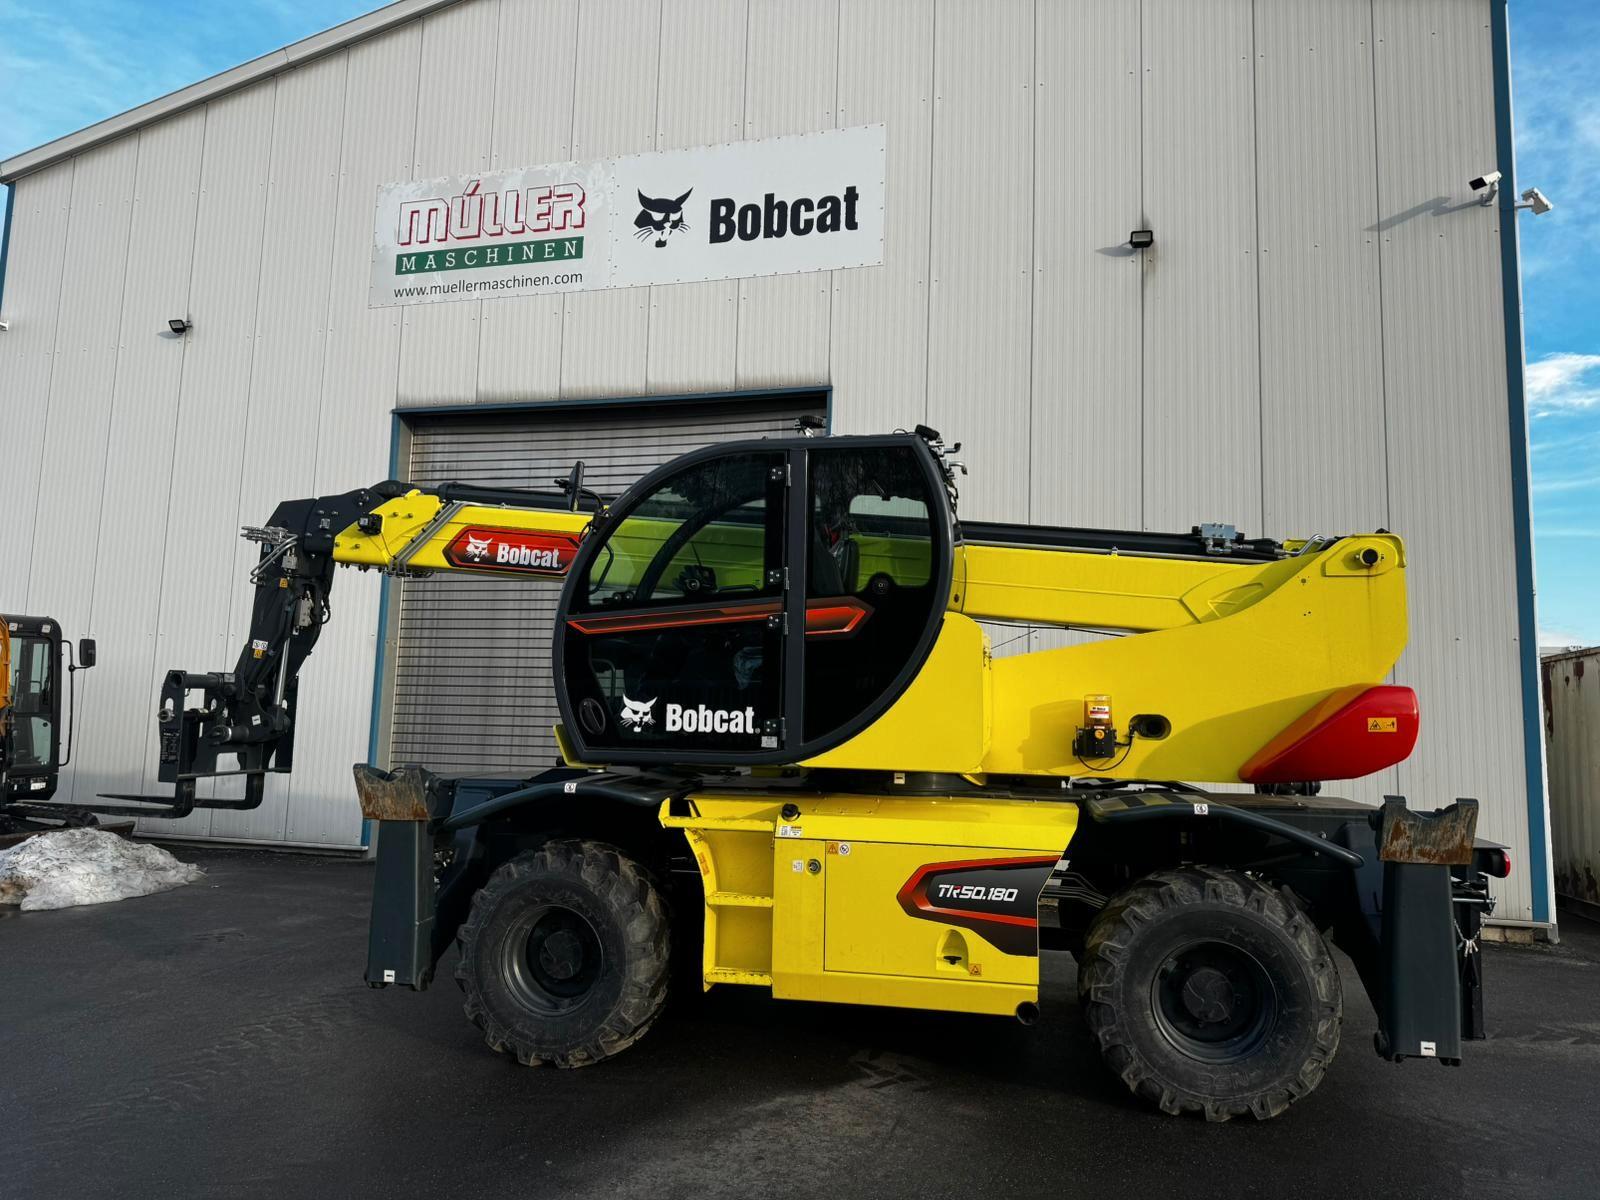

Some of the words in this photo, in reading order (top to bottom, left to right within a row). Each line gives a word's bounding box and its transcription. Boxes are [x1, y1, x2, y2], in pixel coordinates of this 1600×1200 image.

[709, 185, 859, 244] Bobcat
[401, 240, 577, 271] MASCHINEN
[394, 273, 583, 298] www.muellermaschinen.com
[496, 542, 560, 568] Bobcat
[665, 703, 755, 734] Bobcat
